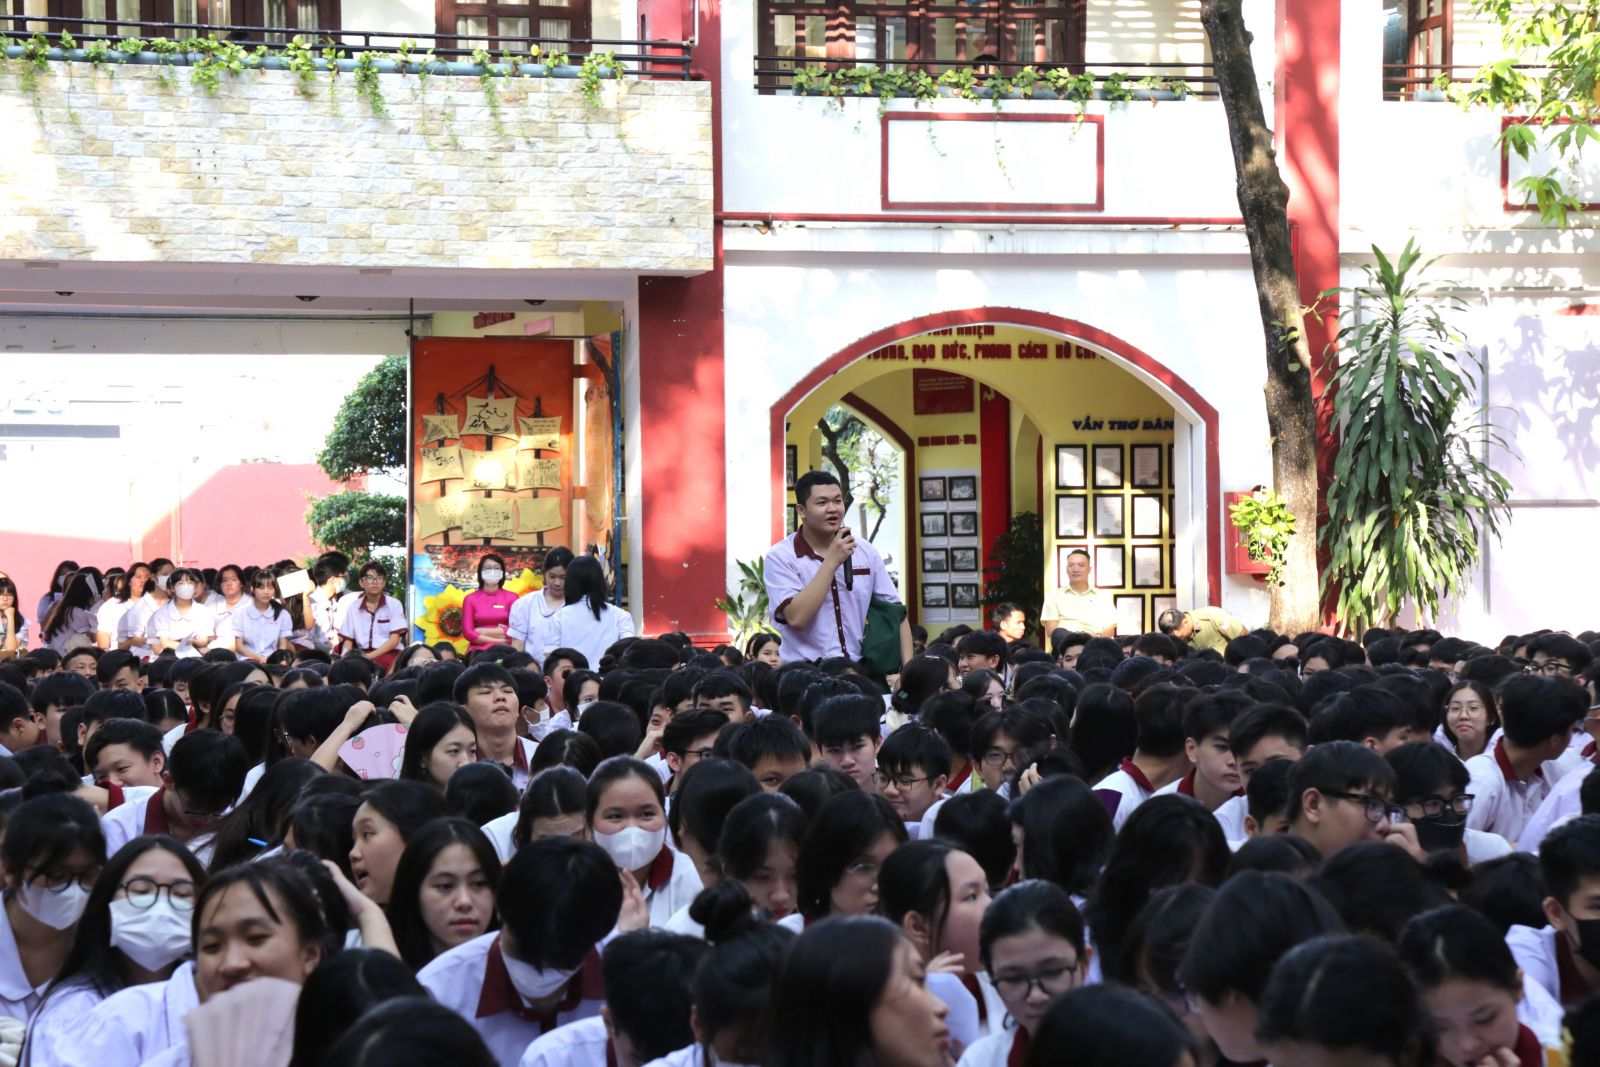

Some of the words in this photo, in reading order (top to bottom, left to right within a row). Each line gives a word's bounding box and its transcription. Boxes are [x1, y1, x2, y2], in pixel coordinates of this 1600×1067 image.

[912, 344, 936, 363] ĐẠO
[974, 344, 1011, 360] PHONG
[1018, 341, 1048, 360] CÁCH
[1107, 419, 1140, 431] THƠ
